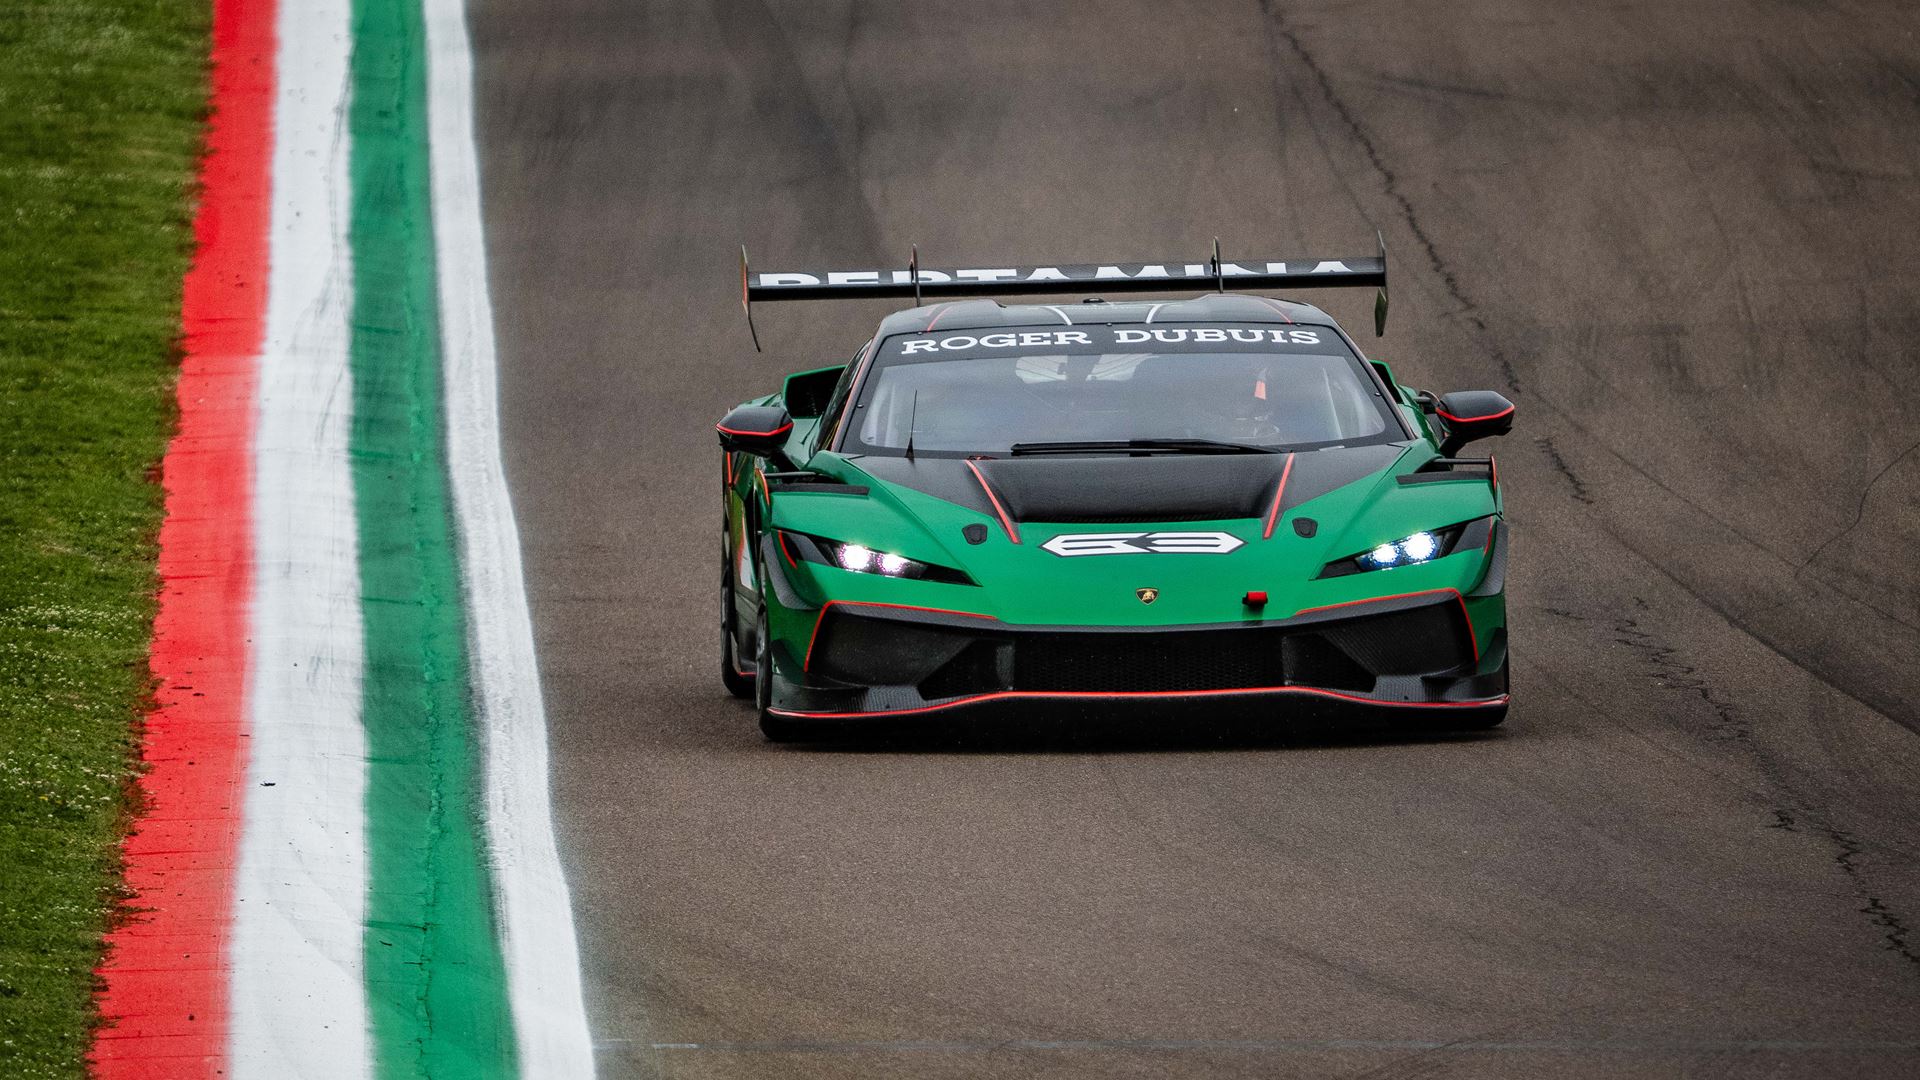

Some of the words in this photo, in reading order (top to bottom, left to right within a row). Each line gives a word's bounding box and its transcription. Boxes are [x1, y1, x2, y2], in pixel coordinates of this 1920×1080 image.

[901, 331, 1092, 354] ROGER
[1115, 329, 1321, 344] DUBUIS
[1040, 531, 1247, 557] 63
